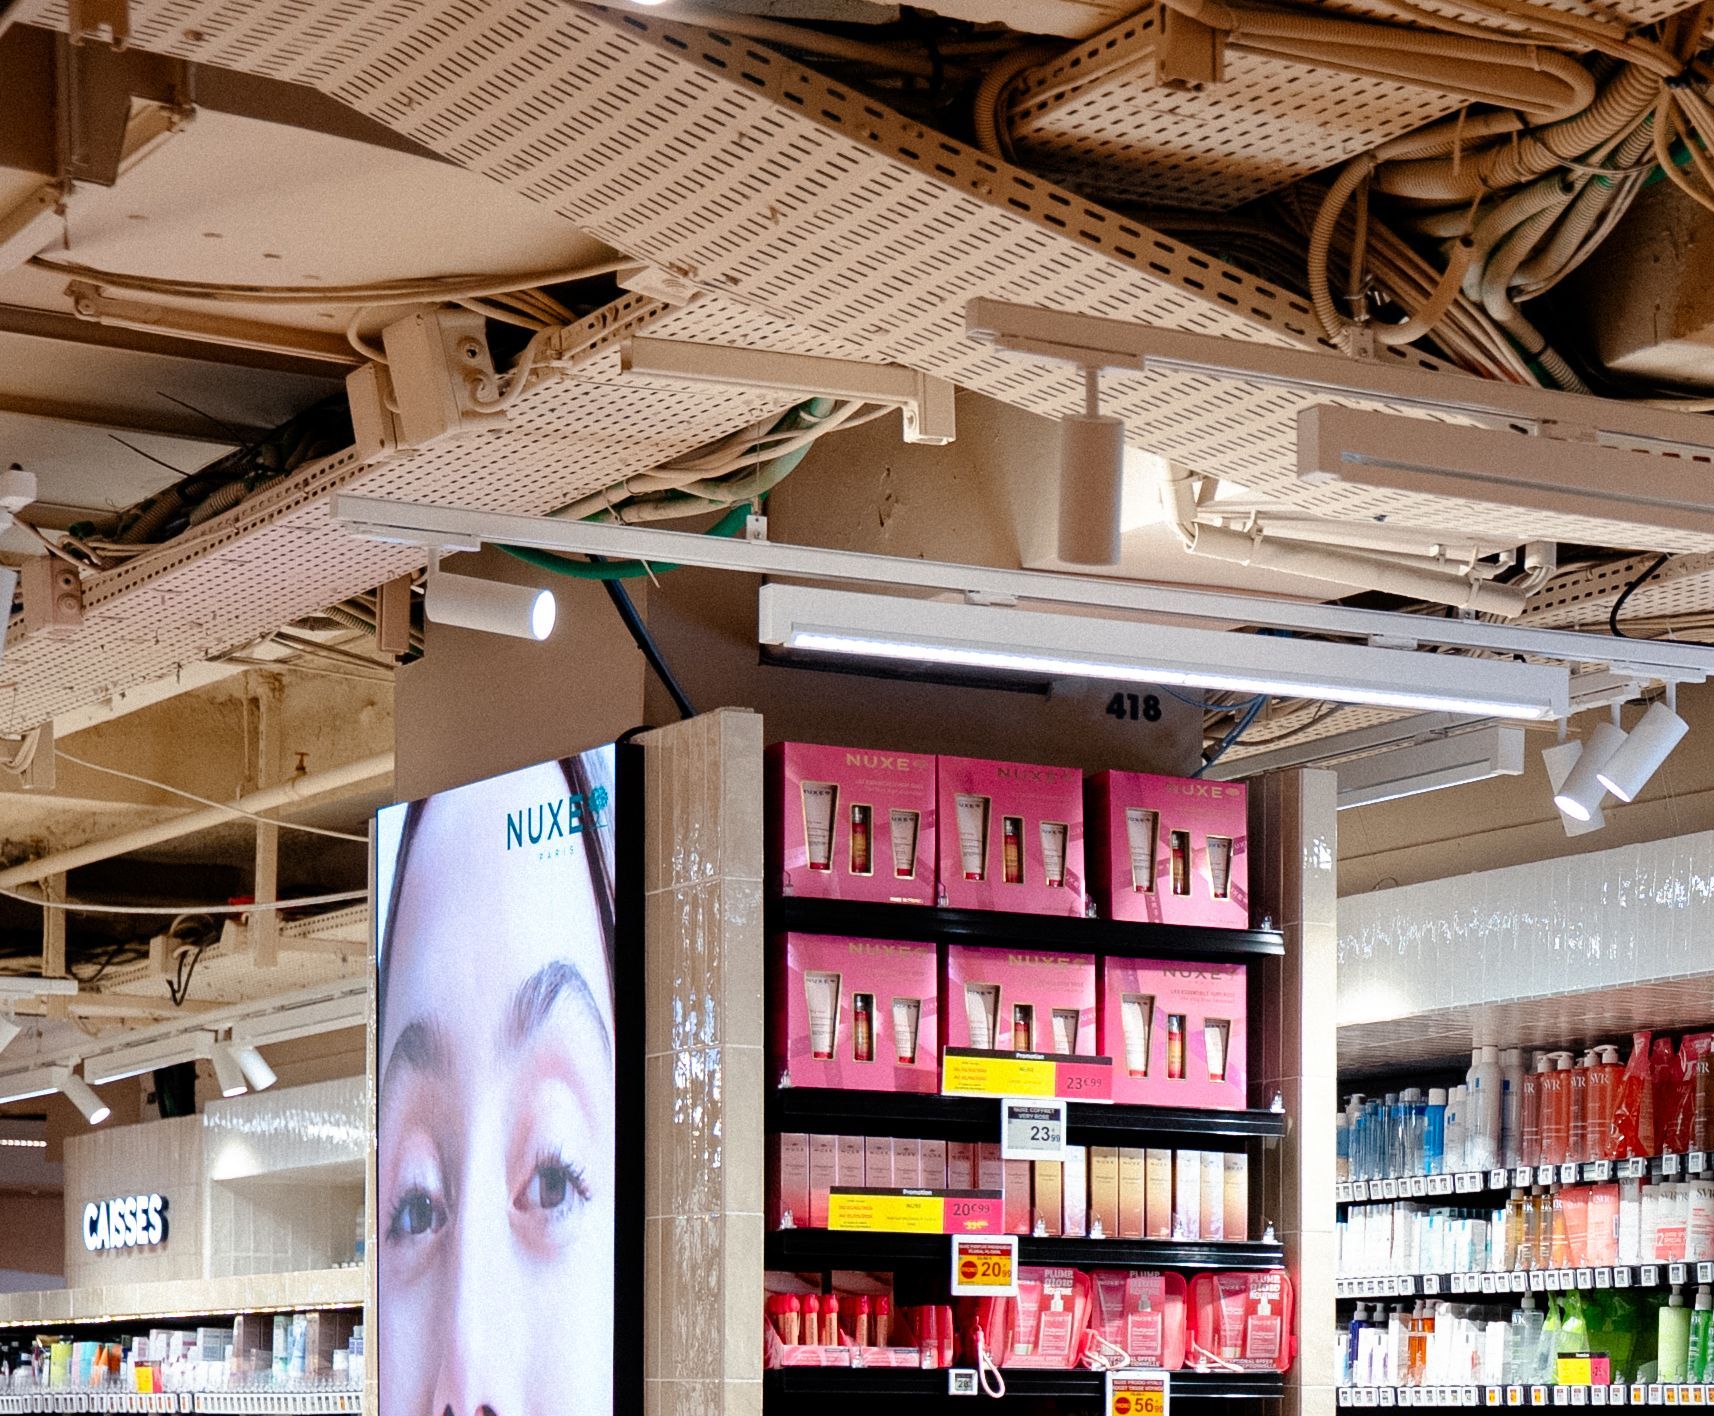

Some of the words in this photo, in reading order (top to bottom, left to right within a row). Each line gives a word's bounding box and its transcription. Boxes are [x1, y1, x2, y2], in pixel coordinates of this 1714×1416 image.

[1106, 692, 1162, 722] 418
[846, 752, 910, 771] NUXE
[1166, 783, 1223, 798] NUXE
[507, 794, 583, 850] NUXE
[1008, 954, 1070, 968] NUXE
[1162, 966, 1222, 981] NUXE
[1066, 1077, 1102, 1090] 23€99
[1543, 1079, 1561, 1091] SVR
[1589, 1072, 1609, 1085] SVR
[953, 1203, 990, 1216] 20€99
[83, 1193, 169, 1251] CAISSES
[1129, 1270, 1161, 1278] PLUMP
[1135, 1397, 1154, 1413] 56
